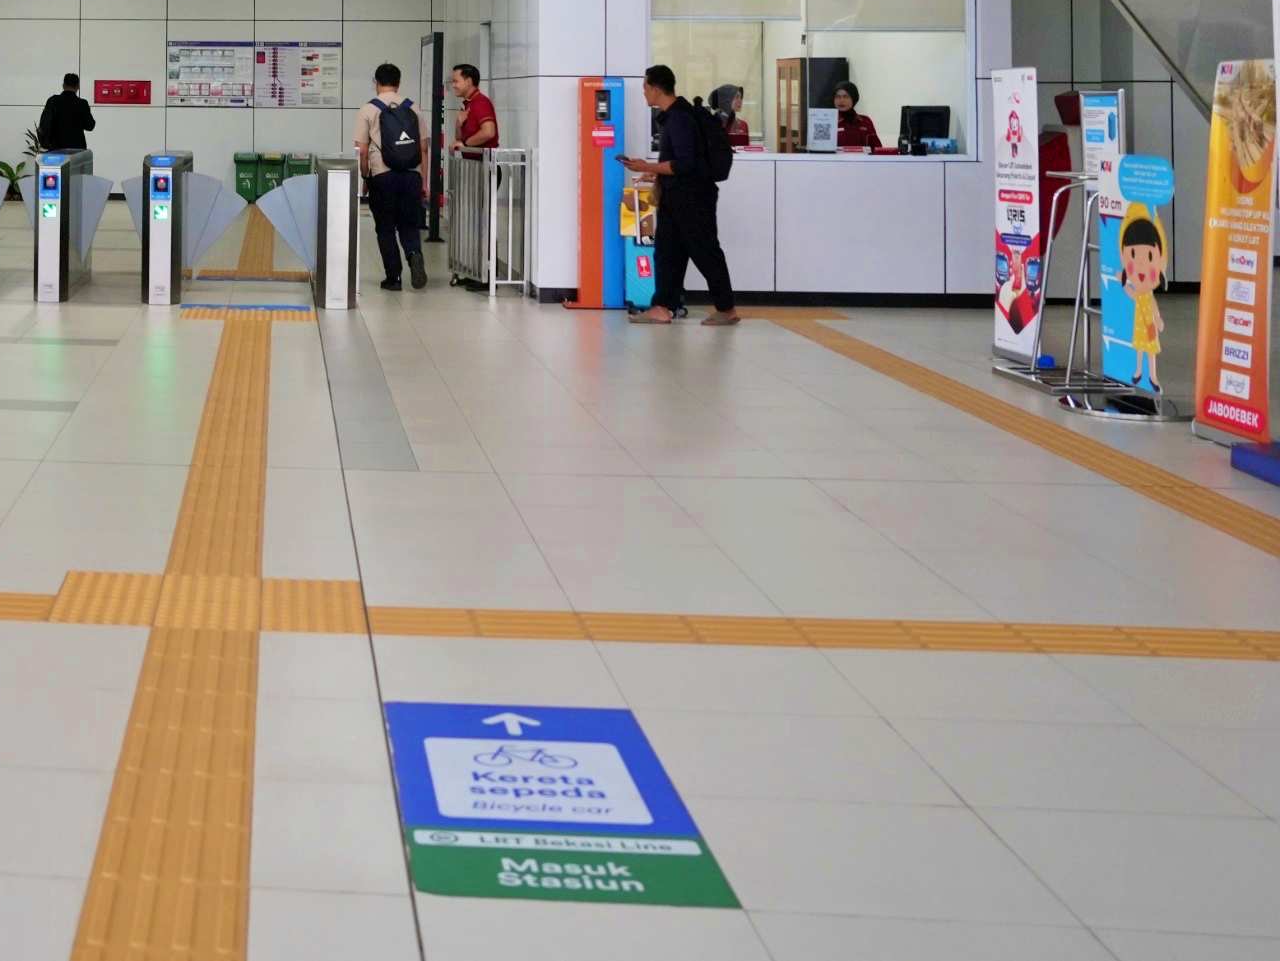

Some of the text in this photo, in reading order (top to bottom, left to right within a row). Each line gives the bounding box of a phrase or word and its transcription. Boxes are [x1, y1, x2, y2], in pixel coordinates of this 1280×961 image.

[1100, 196, 1122, 210] 90 cm
[1224, 345, 1249, 361] BRIZZI
[1207, 399, 1259, 428] JABODEBEK
[471, 770, 595, 786] Kereta
[469, 784, 608, 800] sepeda
[471, 800, 615, 815] Bicycle car
[479, 835, 673, 851] LRT Bekasi Line
[500, 857, 632, 878] Masuk
[497, 871, 646, 892] Stasiun
